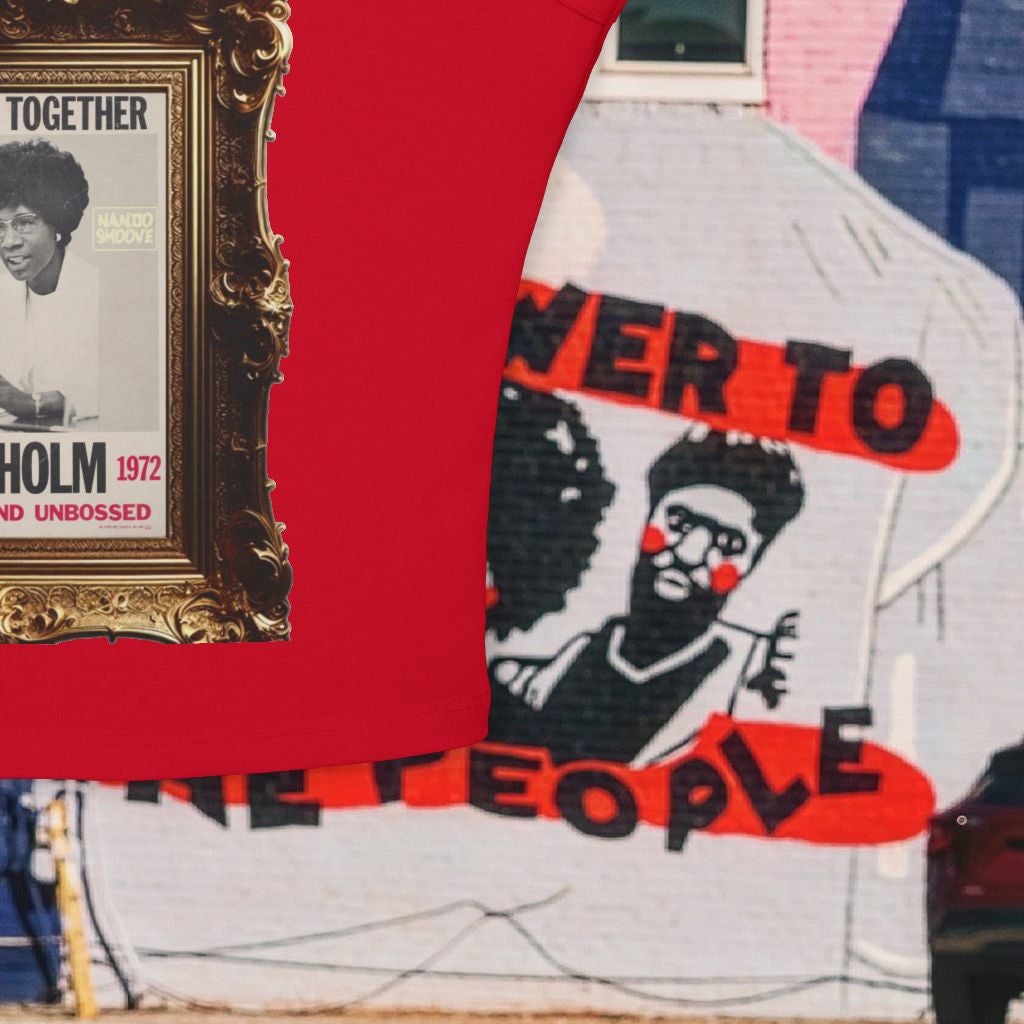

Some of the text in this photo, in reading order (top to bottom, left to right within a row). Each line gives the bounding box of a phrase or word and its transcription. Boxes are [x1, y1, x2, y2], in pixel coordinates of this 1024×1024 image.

[6, 96, 147, 130] TOGETHER
[96, 228, 153, 244] SMOOVE
[785, 340, 933, 454] TO
[116, 455, 162, 481] 1972
[34, 504, 153, 522] UNBOSSED
